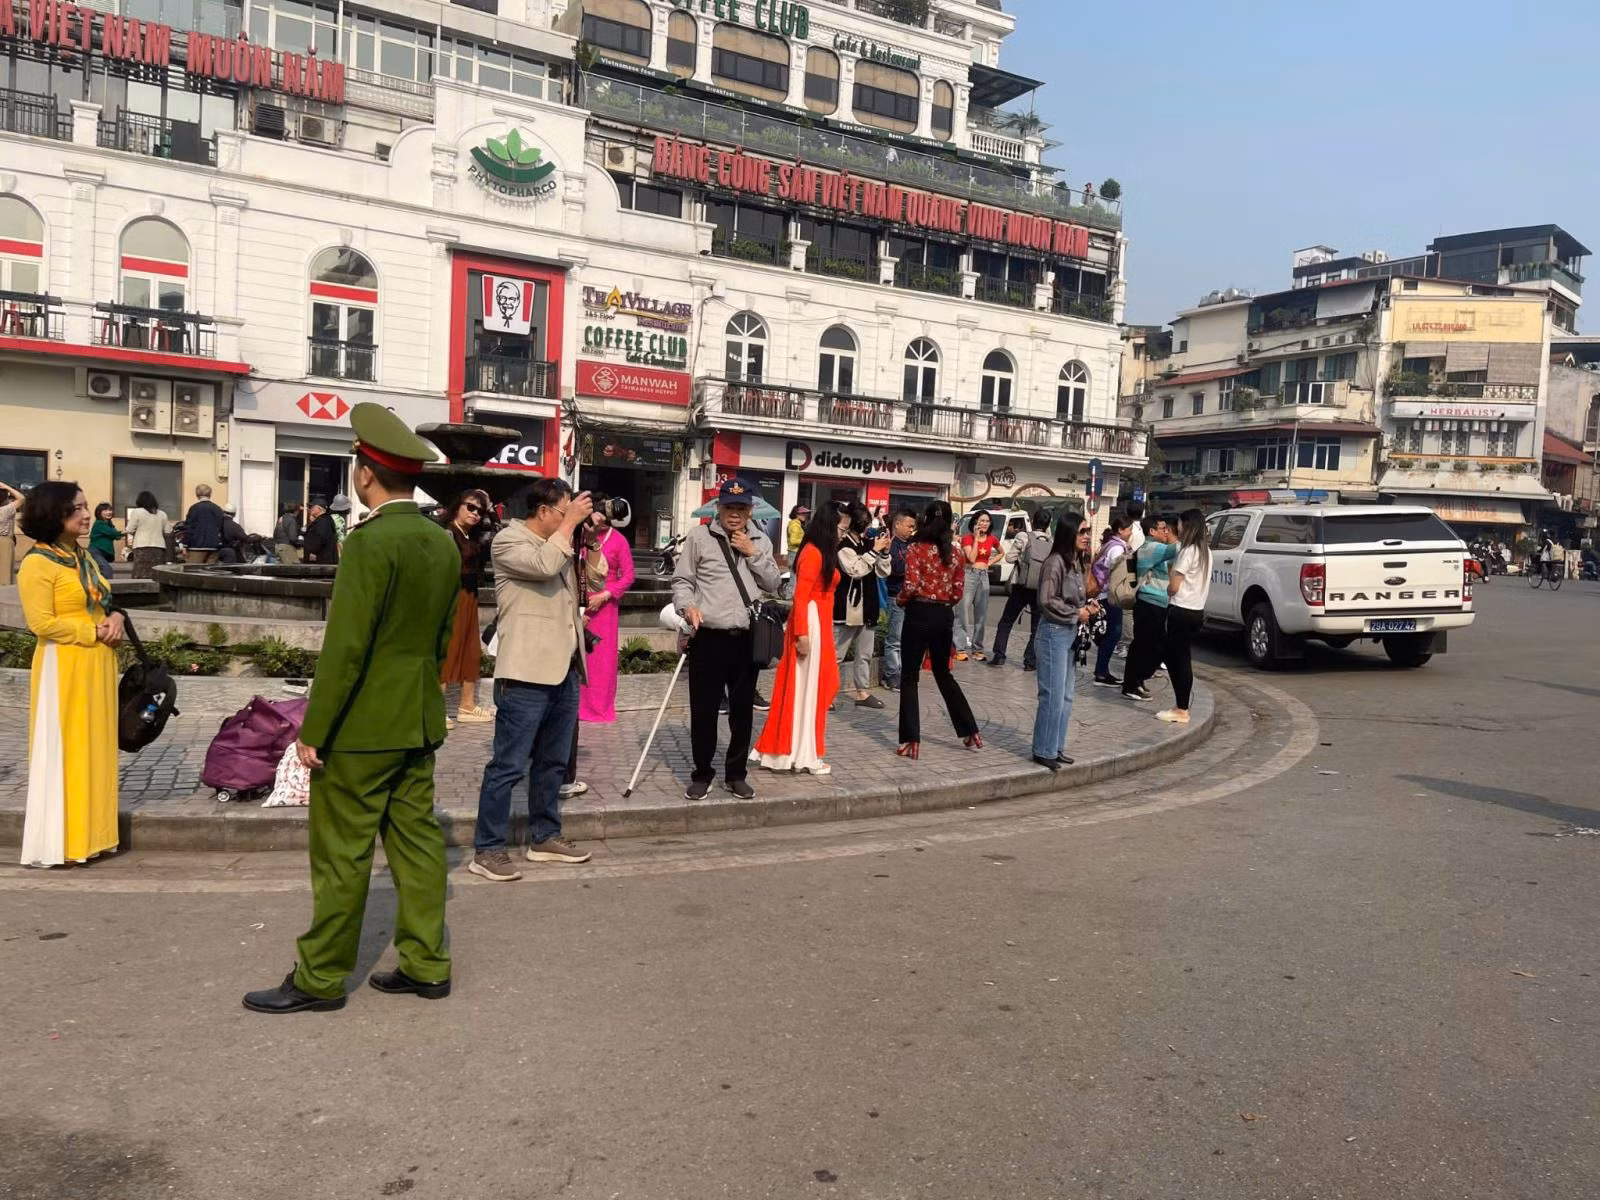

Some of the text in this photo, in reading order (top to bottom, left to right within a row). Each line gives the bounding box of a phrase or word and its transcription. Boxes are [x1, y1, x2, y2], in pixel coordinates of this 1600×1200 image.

[755, 0, 809, 39] CLUB
[102, 12, 171, 66] NAM
[186, 31, 272, 88] MUÔN
[283, 45, 345, 104] NĂM
[600, 57, 639, 73] Vietnamese
[870, 43, 921, 69] Restaurant
[705, 85, 735, 97] Breakfast
[854, 125, 872, 134] Coffee
[467, 164, 557, 198] PHYTOPHARCO
[655, 129, 710, 183] ĐẢNG
[717, 145, 770, 197] CỘNG
[777, 156, 817, 204] SẢN
[821, 168, 860, 217] VIỆT
[861, 181, 907, 221] NAM
[905, 191, 963, 233] QUANG
[967, 203, 1003, 241] VINH
[584, 325, 688, 357] COFFEE CLUB
[621, 374, 678, 390] MANWAH
[621, 384, 654, 394] TAIWANESE
[1430, 407, 1497, 417] HERBALIST
[489, 444, 539, 466] FC
[814, 450, 913, 475] didongviet.vn
[1220, 570, 1233, 586] 113
[1329, 589, 1460, 601] RANGER
